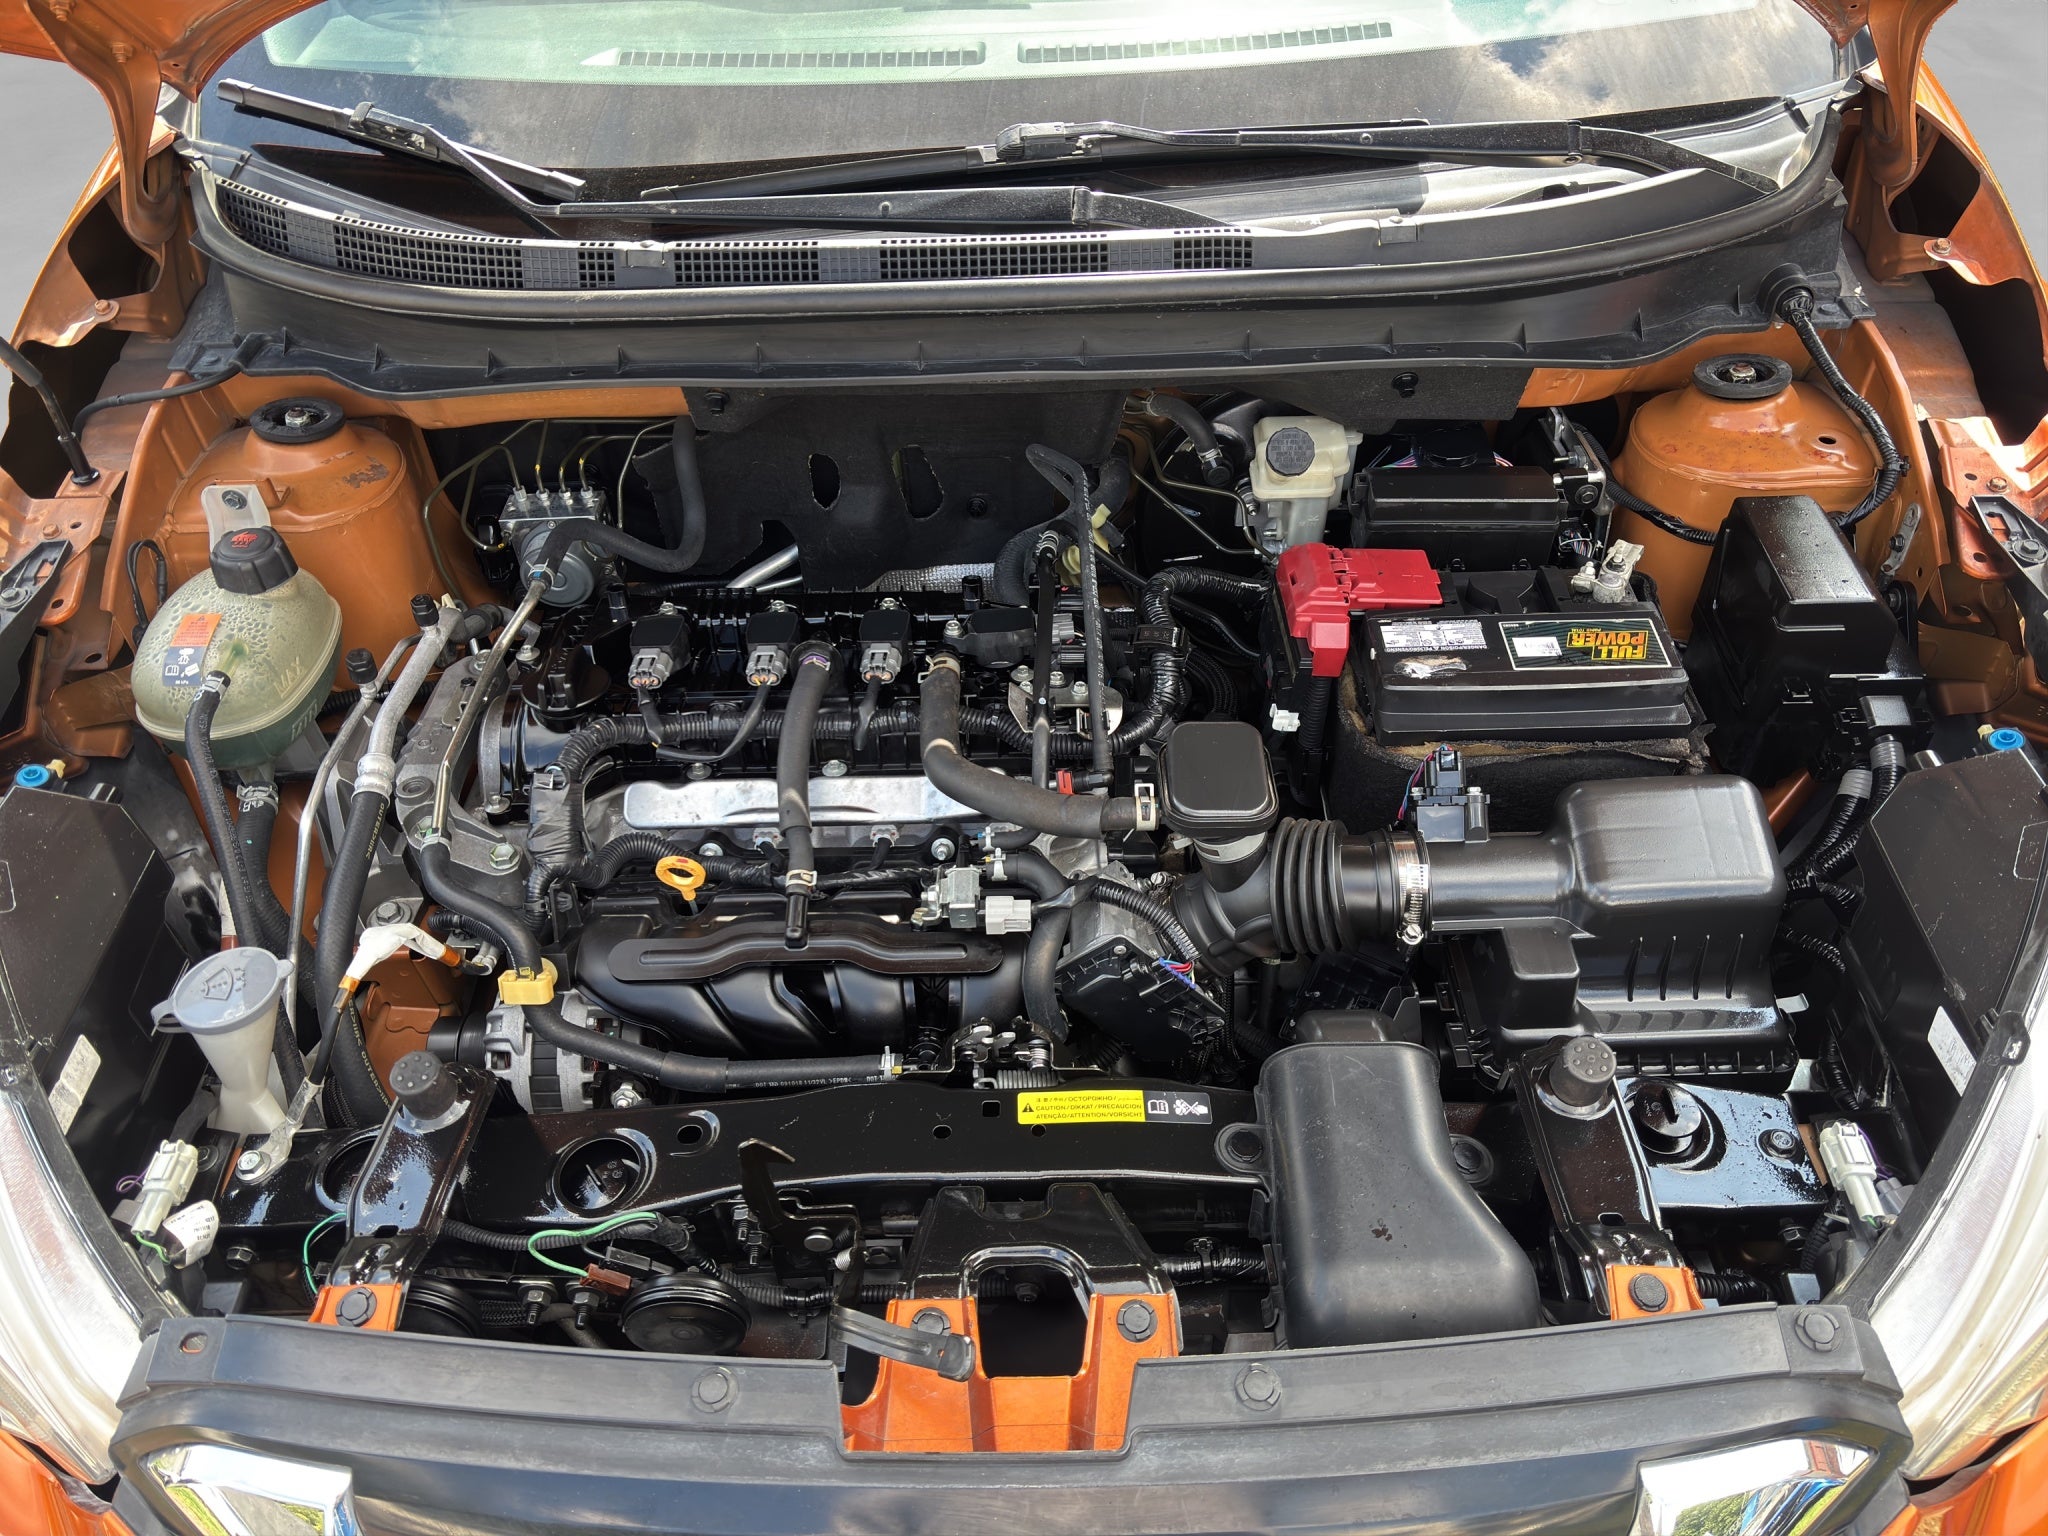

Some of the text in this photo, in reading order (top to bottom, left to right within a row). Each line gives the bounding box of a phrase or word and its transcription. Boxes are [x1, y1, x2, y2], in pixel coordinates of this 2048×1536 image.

[1571, 632, 1645, 647] POWER
[1598, 645, 1644, 659] FULL
[273, 655, 302, 697] MAX
